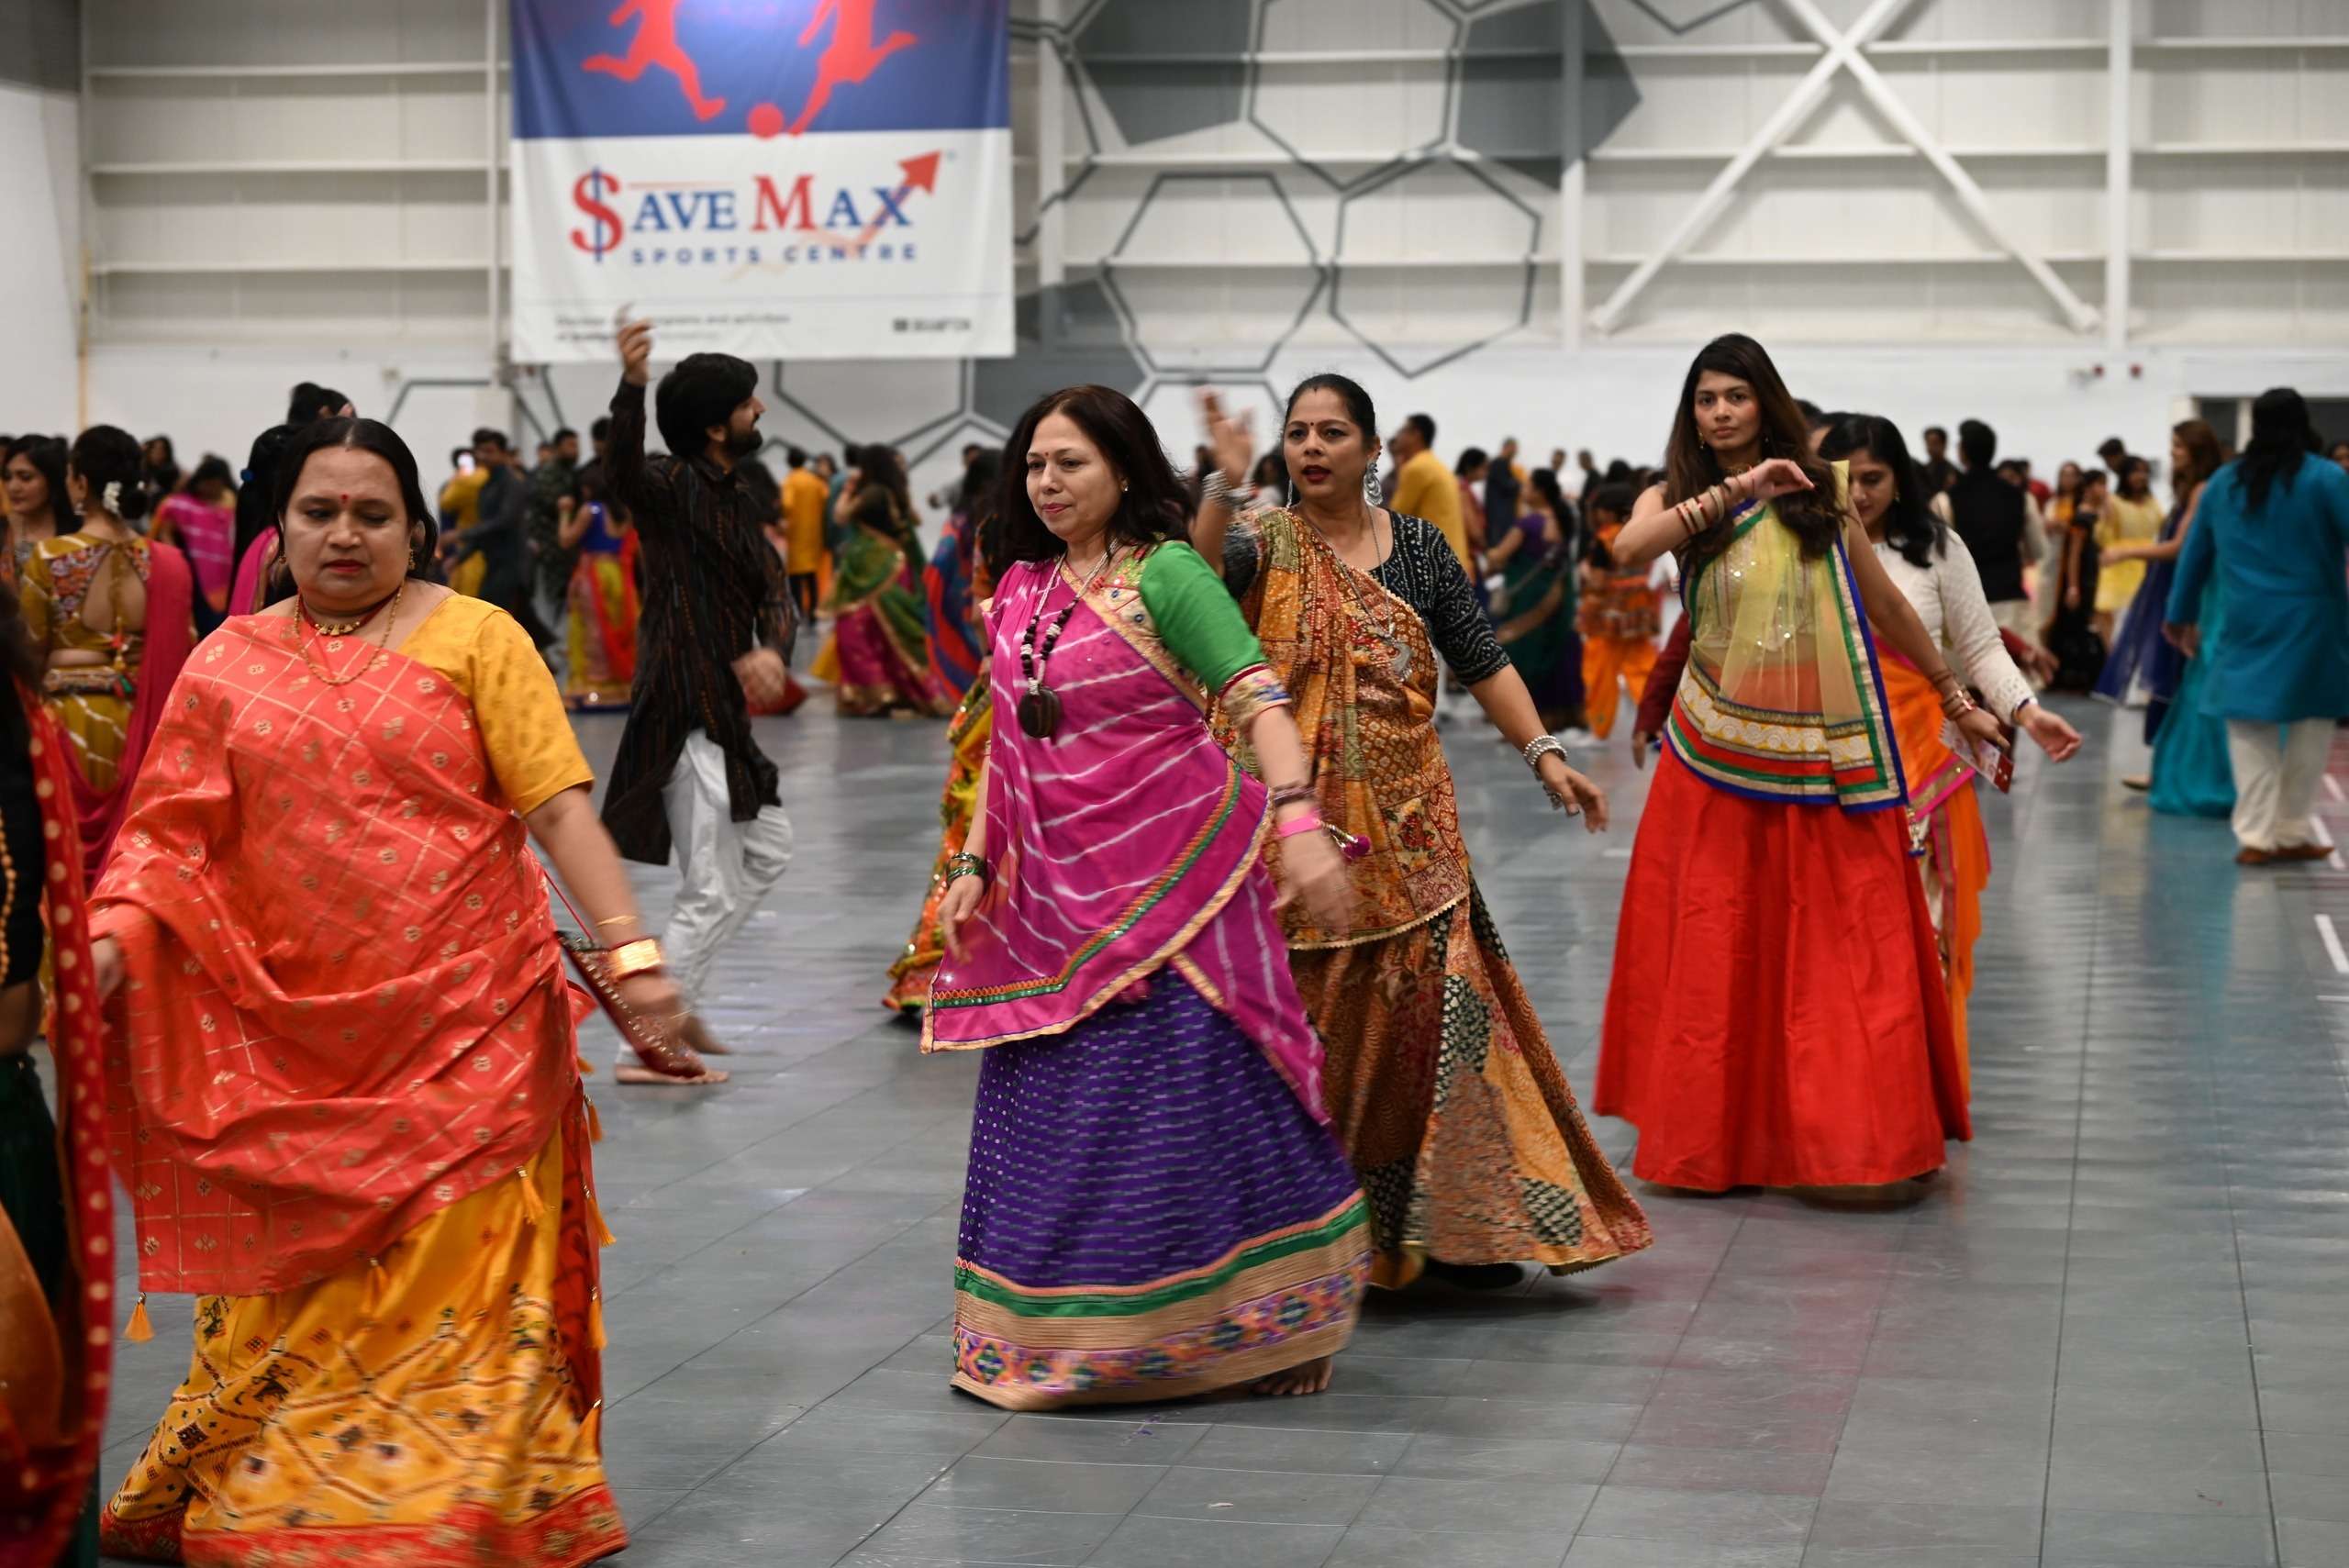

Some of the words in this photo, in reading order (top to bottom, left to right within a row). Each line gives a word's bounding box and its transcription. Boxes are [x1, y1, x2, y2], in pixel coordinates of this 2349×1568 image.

[751, 173, 913, 231] MAX
[630, 246, 761, 265] SPORTS
[782, 242, 917, 263] CENTRE
